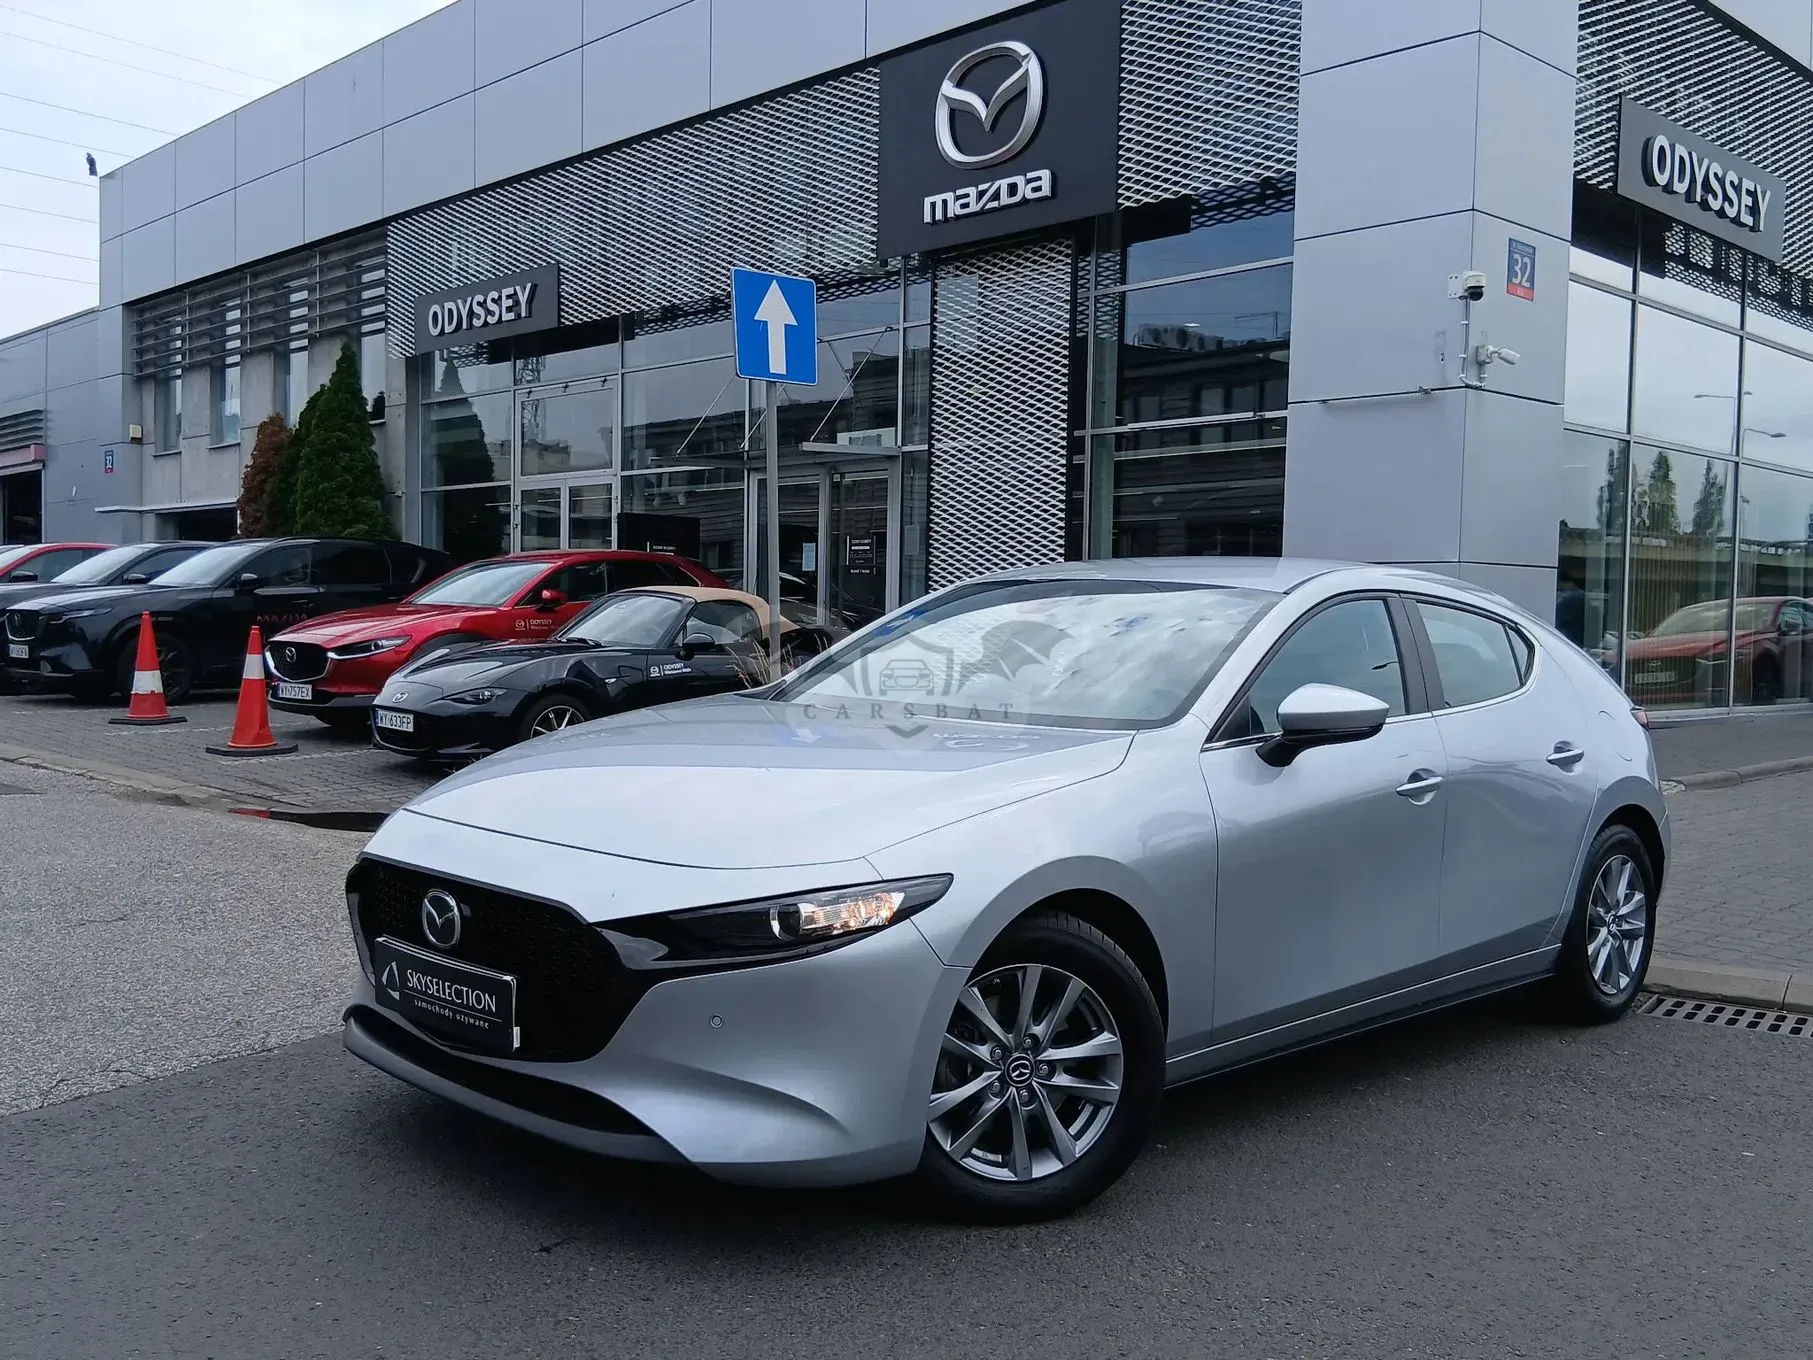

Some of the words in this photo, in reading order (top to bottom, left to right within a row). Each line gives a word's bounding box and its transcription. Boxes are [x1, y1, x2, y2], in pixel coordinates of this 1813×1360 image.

[923, 168, 1052, 224] mazda
[1651, 133, 1772, 232] ODYSSEY
[1512, 253, 1531, 287] 32
[428, 282, 533, 336] ODYSSEY
[390, 714, 412, 729] 633FP
[406, 969, 496, 1013] SKYSELECTION
[414, 999, 453, 1020] samochody
